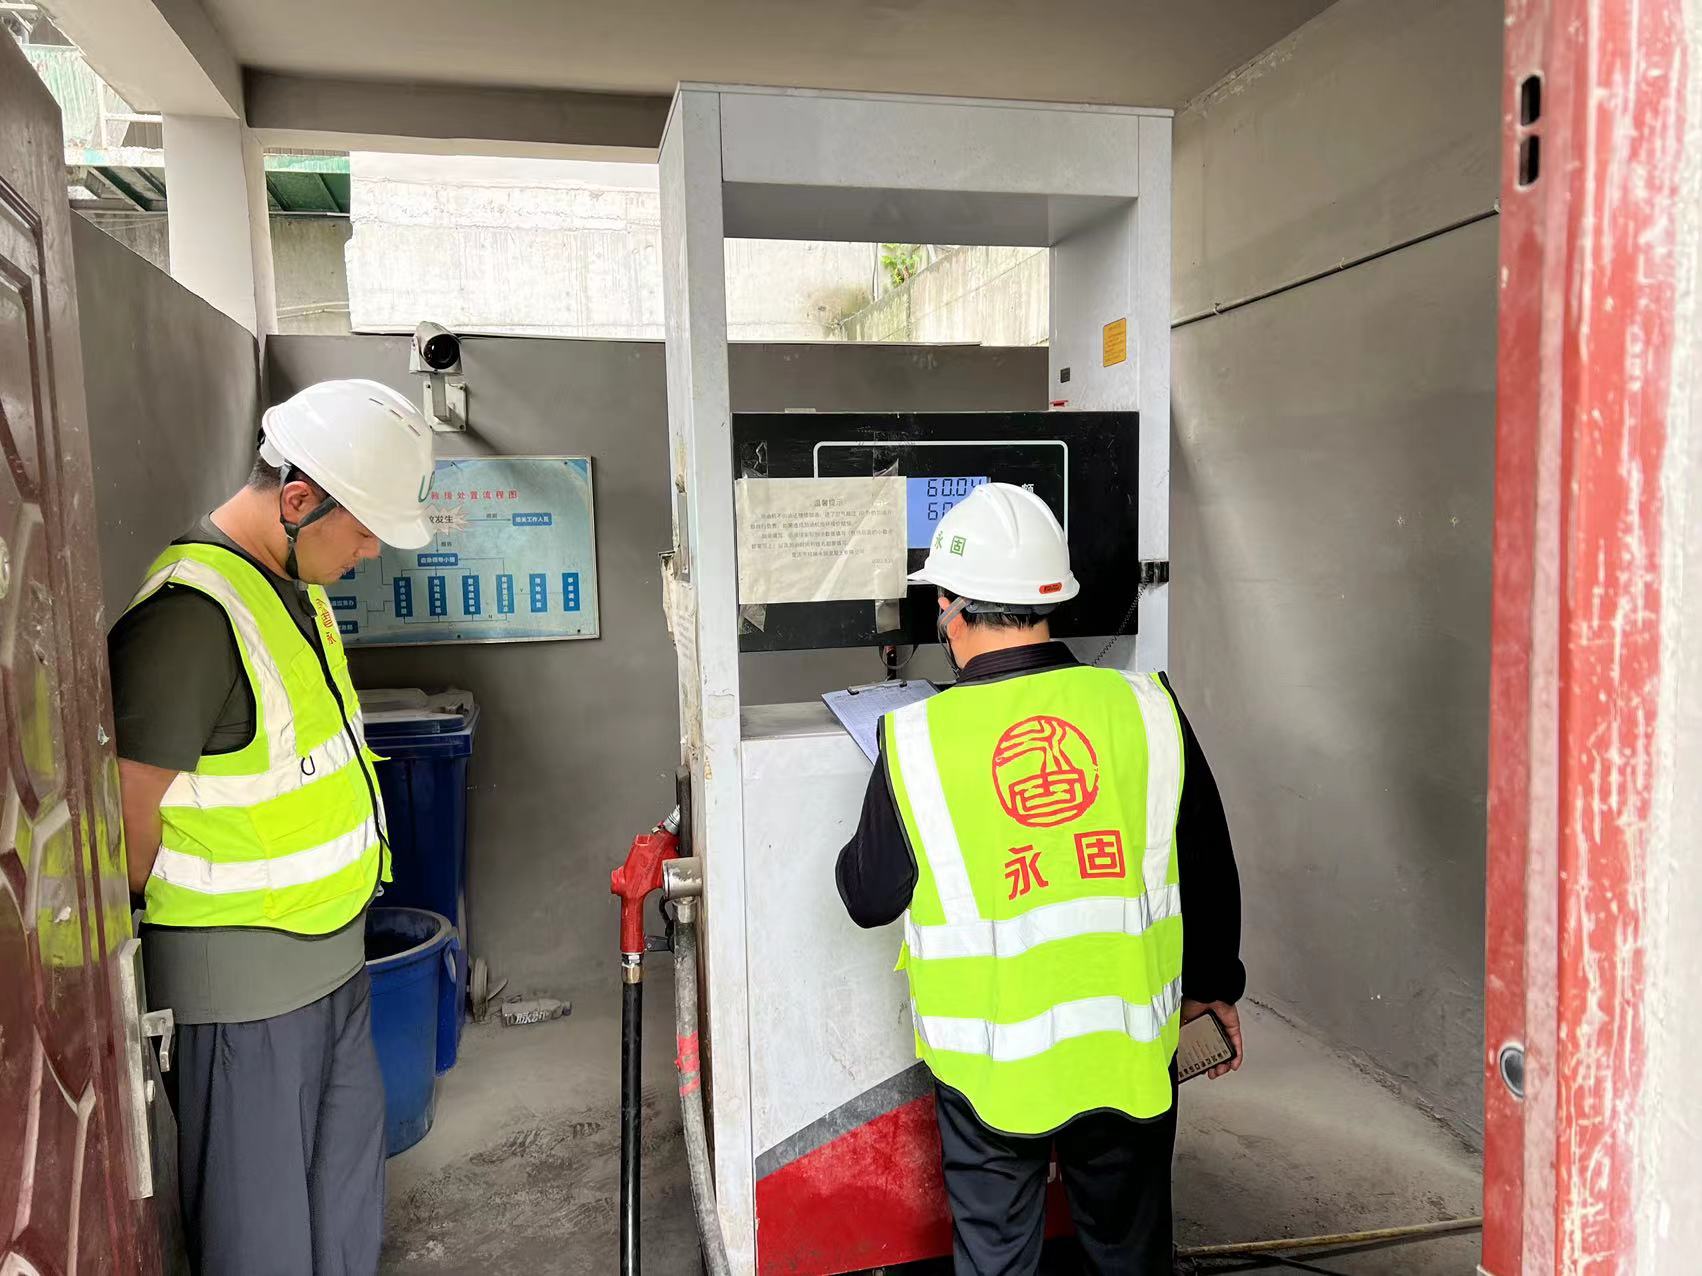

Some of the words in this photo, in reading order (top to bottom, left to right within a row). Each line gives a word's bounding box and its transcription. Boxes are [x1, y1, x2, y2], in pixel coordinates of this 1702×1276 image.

[815, 499, 841, 507] 温馨提示
[1004, 830, 1126, 900] 永固
